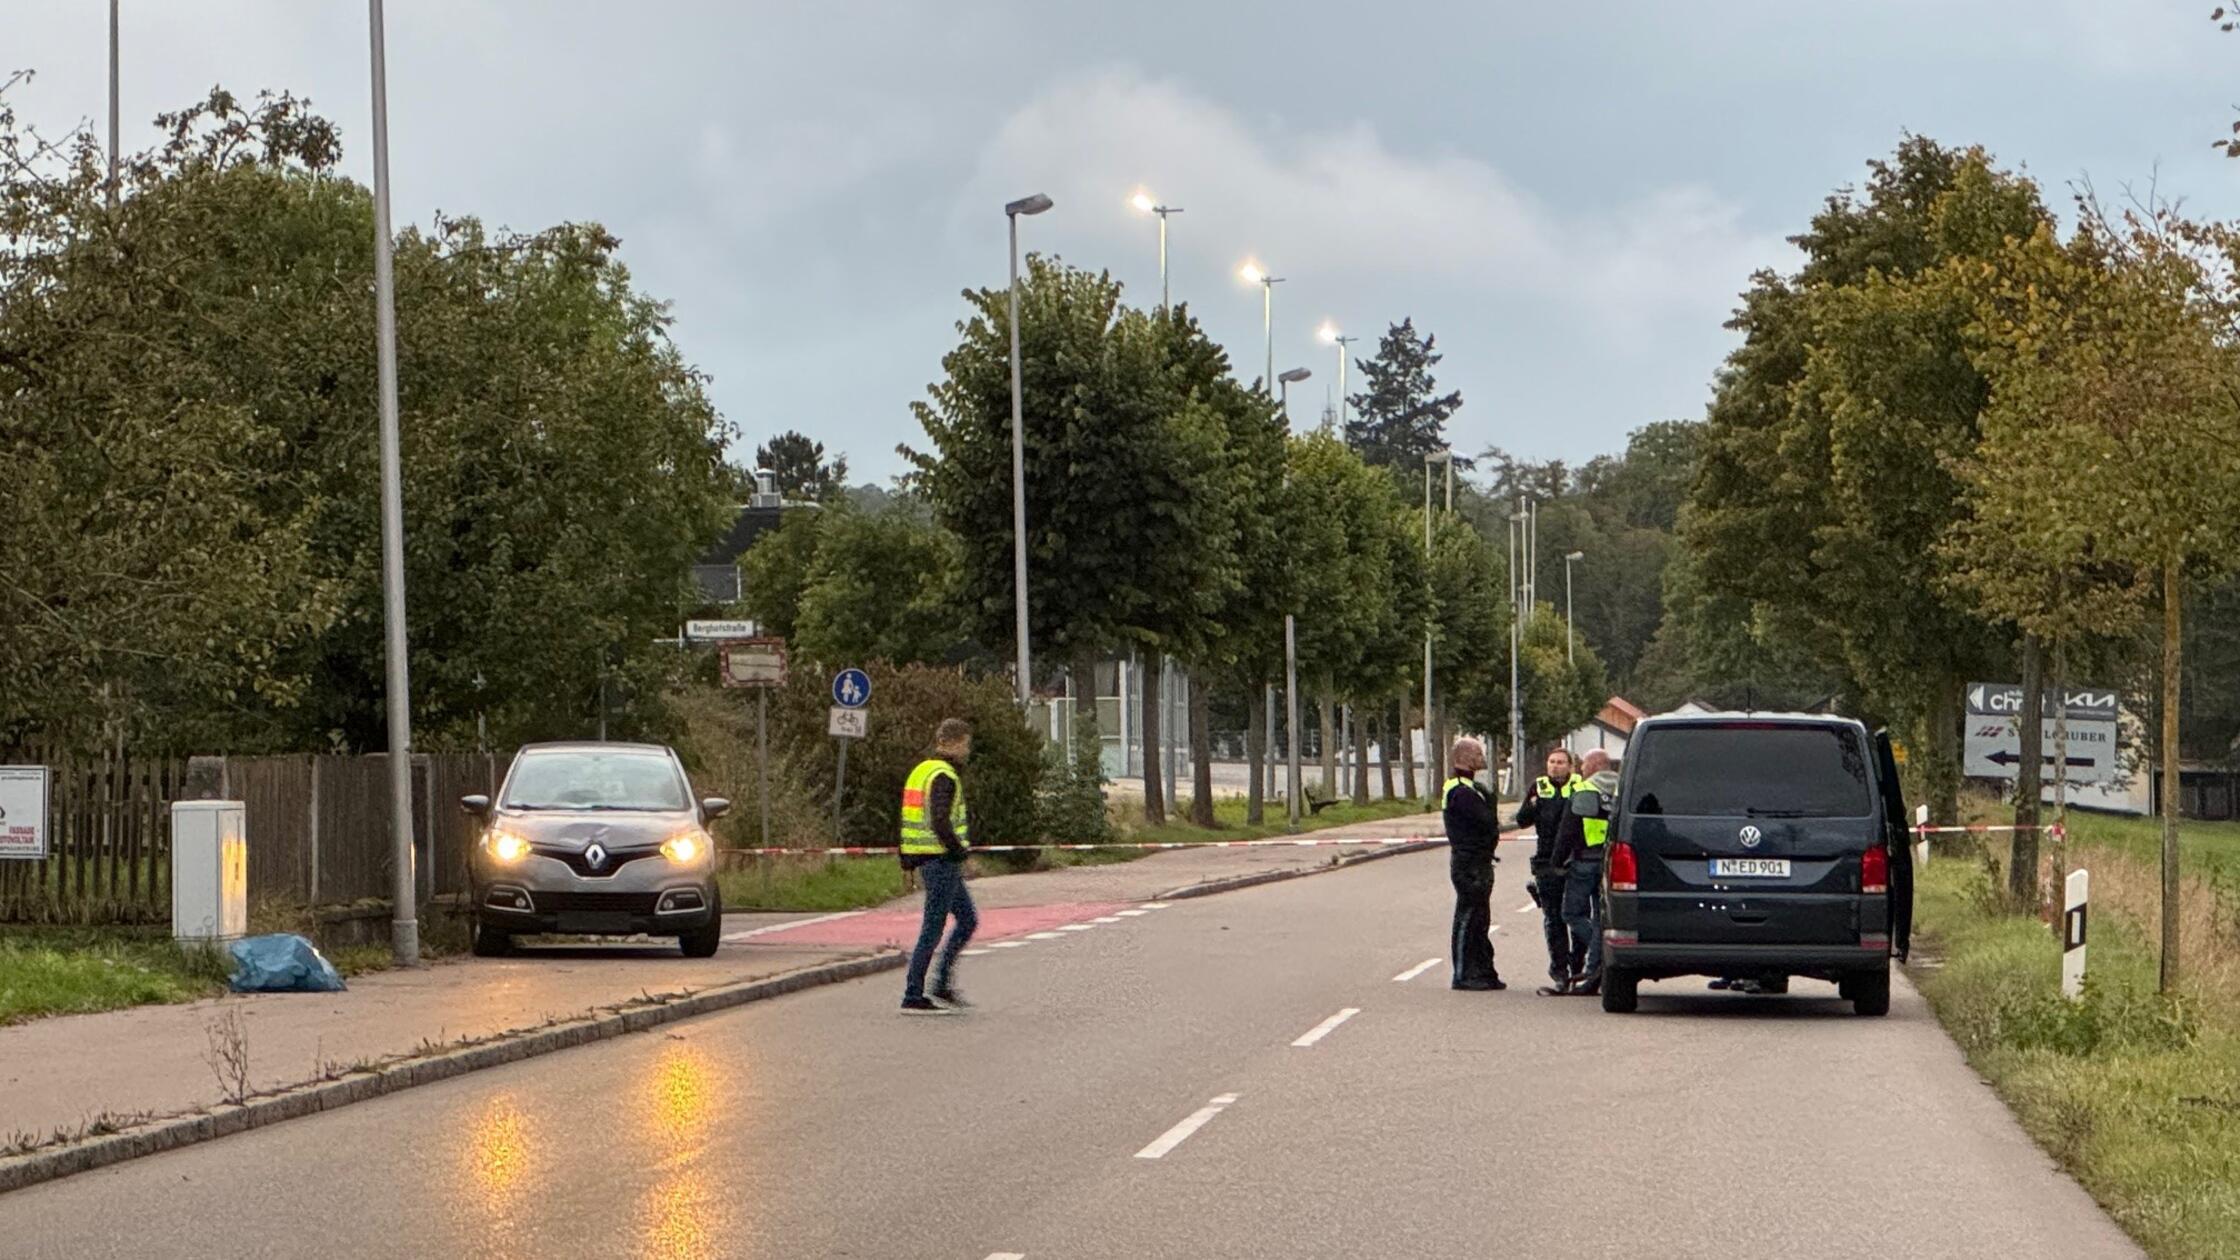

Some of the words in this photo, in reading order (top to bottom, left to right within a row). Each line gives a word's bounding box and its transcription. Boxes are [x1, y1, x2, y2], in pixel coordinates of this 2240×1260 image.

[2008, 727, 2106, 743] SLUBER
[1722, 861, 1731, 873] N
[1739, 861, 1757, 873] ED
[1760, 861, 1784, 874] 901
